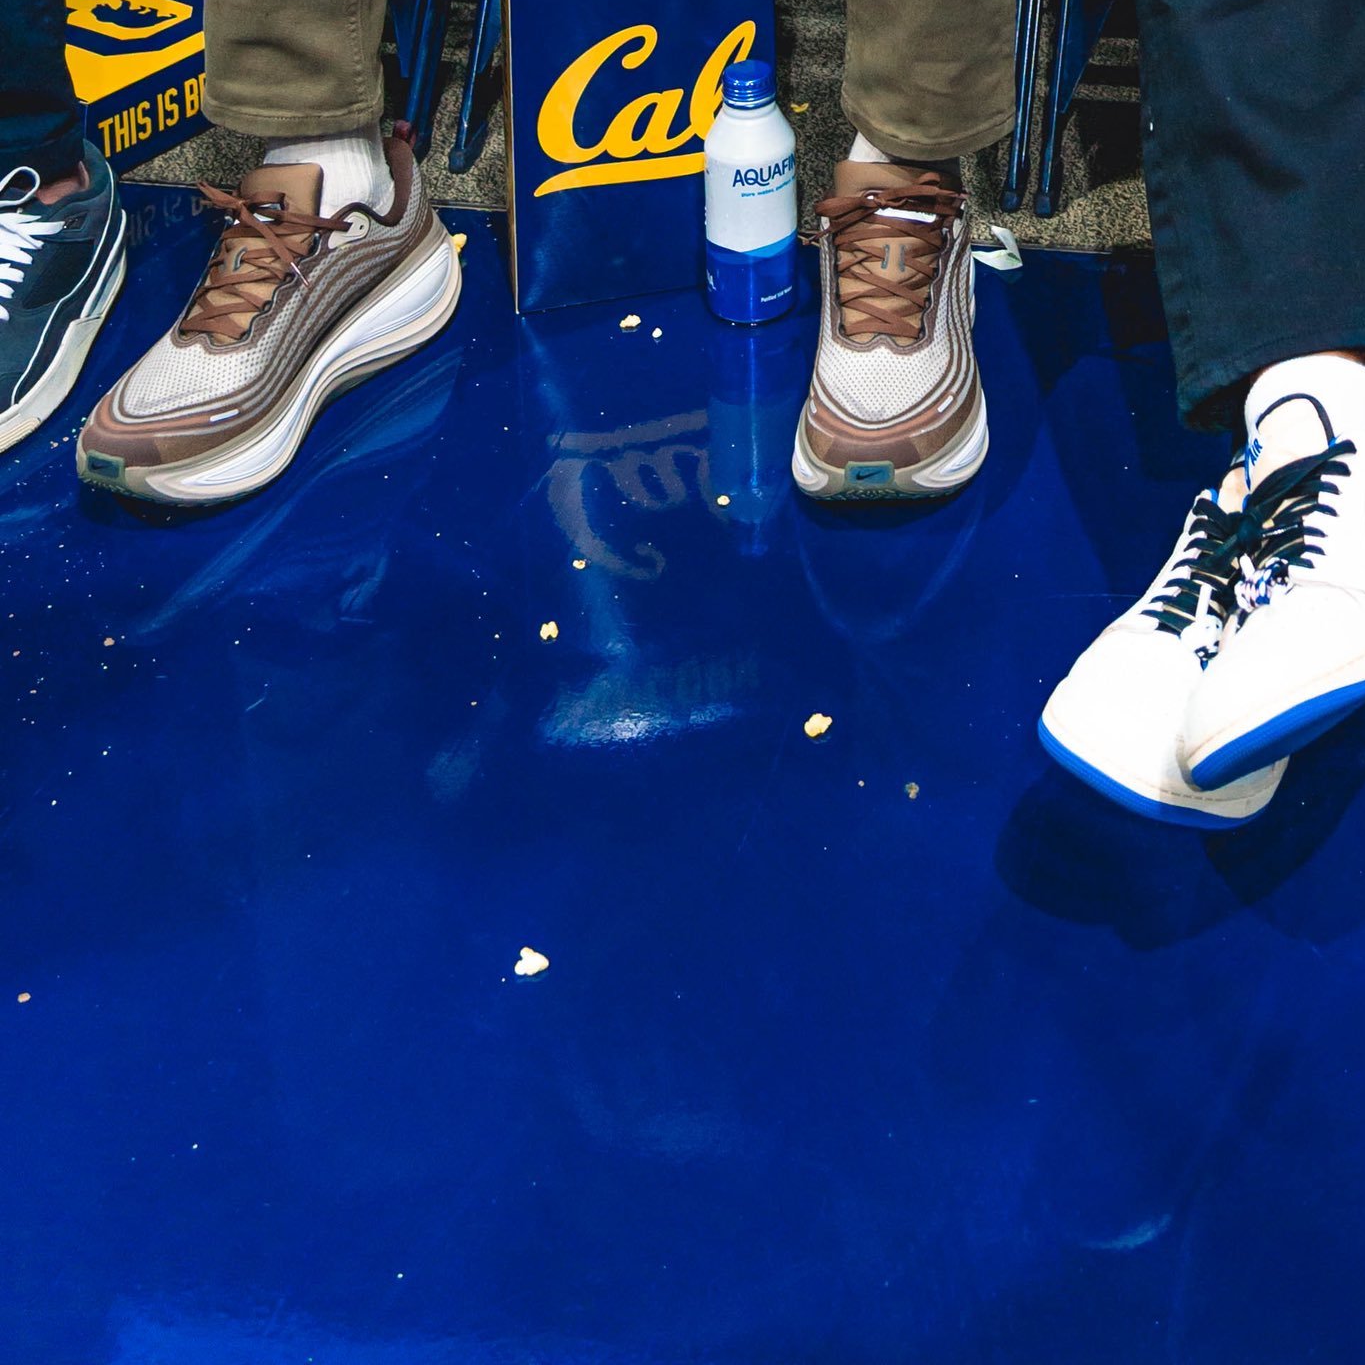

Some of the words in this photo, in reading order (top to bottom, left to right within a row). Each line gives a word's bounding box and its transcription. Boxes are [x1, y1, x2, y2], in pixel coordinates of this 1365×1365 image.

[98, 100, 152, 158] THIS
[156, 87, 180, 132] IS
[534, 20, 756, 197] Cal
